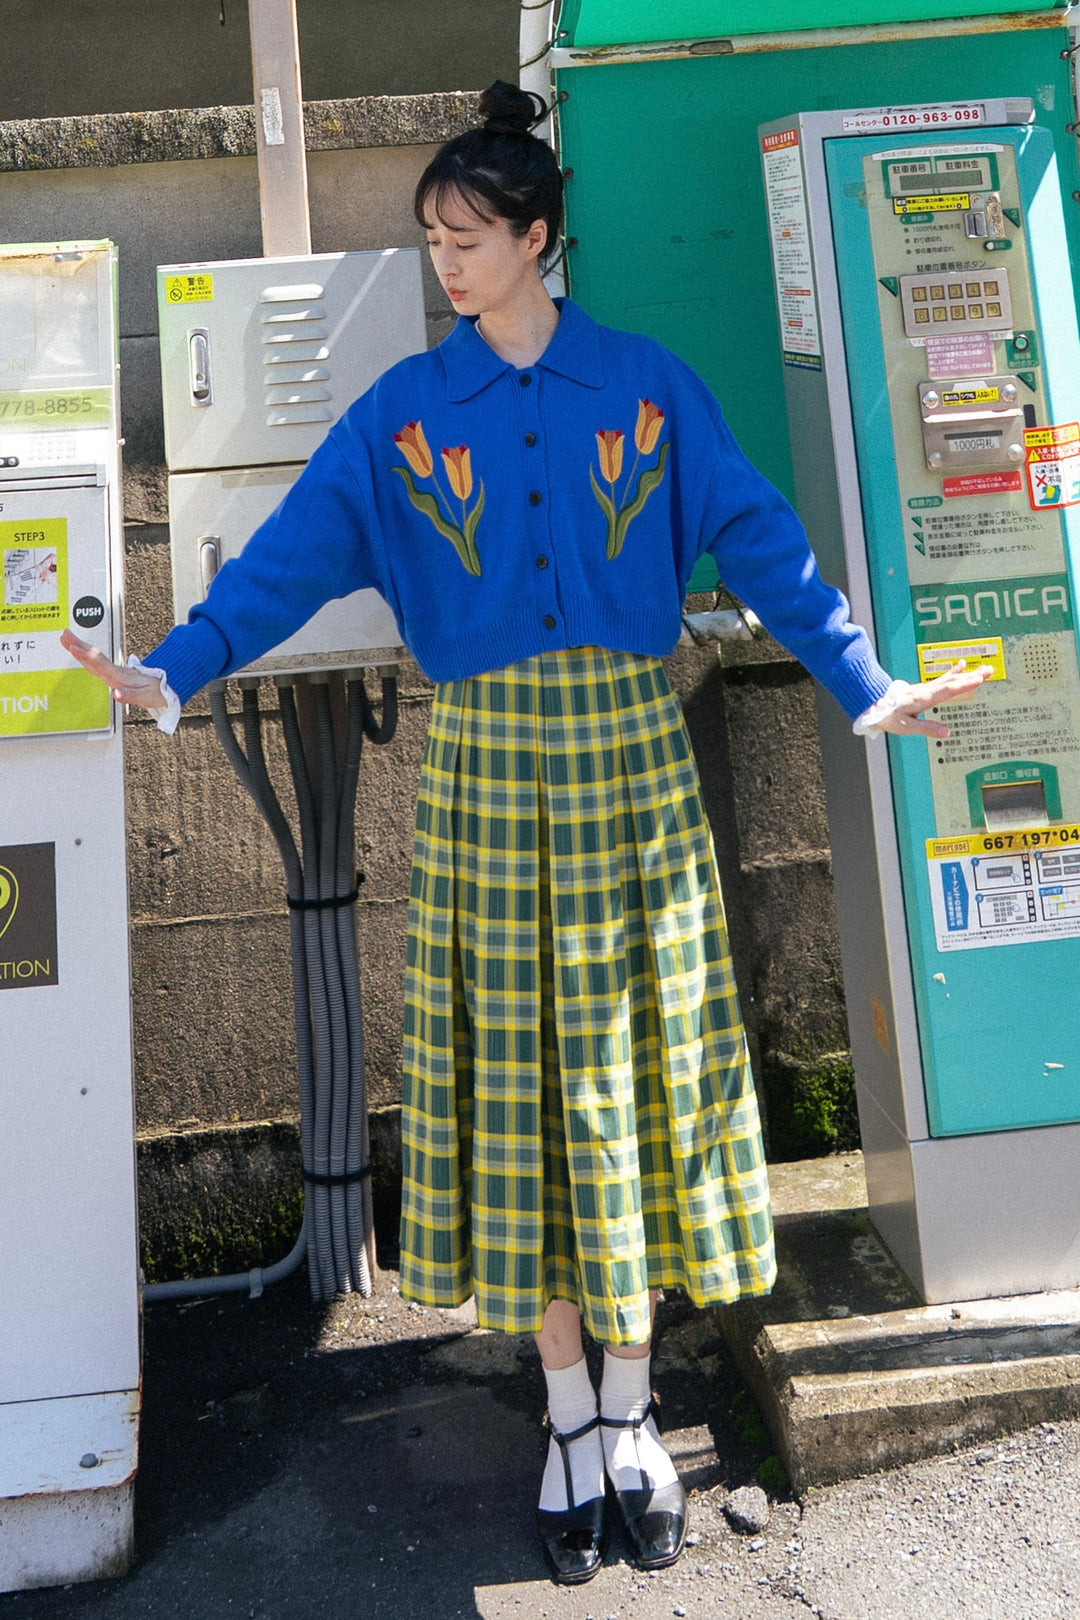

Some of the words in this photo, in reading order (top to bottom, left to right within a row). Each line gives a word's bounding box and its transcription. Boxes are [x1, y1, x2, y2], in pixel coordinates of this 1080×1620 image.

[844, 120, 883, 128] コールセンター
[883, 110, 979, 126] 0120-963-098
[892, 164, 926, 174] 駐車番号
[946, 160, 979, 170] 駐車料金
[916, 260, 986, 272] 駐車位置番号ボタン
[954, 438, 995, 450] 1000円札
[14, 531, 45, 542] STEP3
[915, 585, 1068, 626] SANICA
[76, 607, 102, 618] PUSH
[2, 695, 48, 714] TION
[983, 836, 1014, 850] 667
[0, 958, 50, 979] TION
